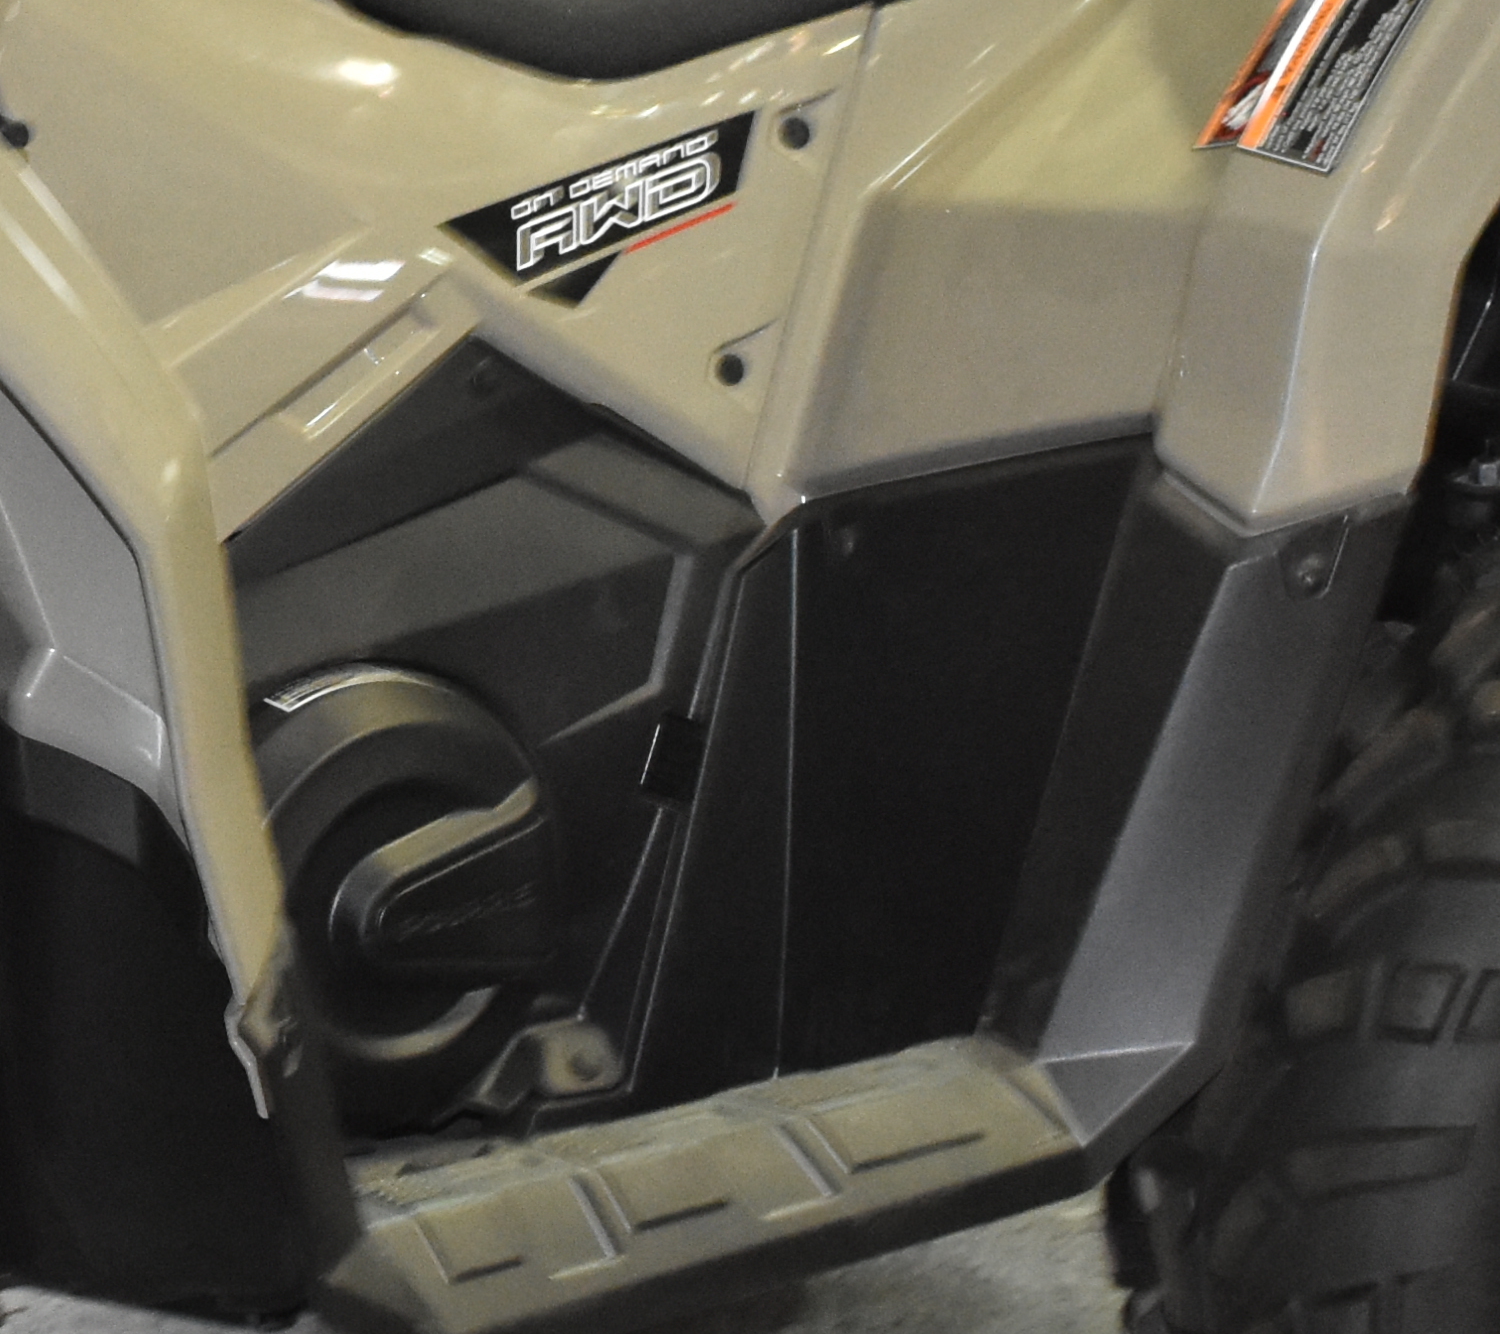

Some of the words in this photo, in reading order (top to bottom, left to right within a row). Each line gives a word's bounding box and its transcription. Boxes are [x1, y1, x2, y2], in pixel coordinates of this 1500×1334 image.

[510, 185, 565, 221] ON
[569, 129, 719, 199] DEMAND
[515, 150, 722, 272] AWD
